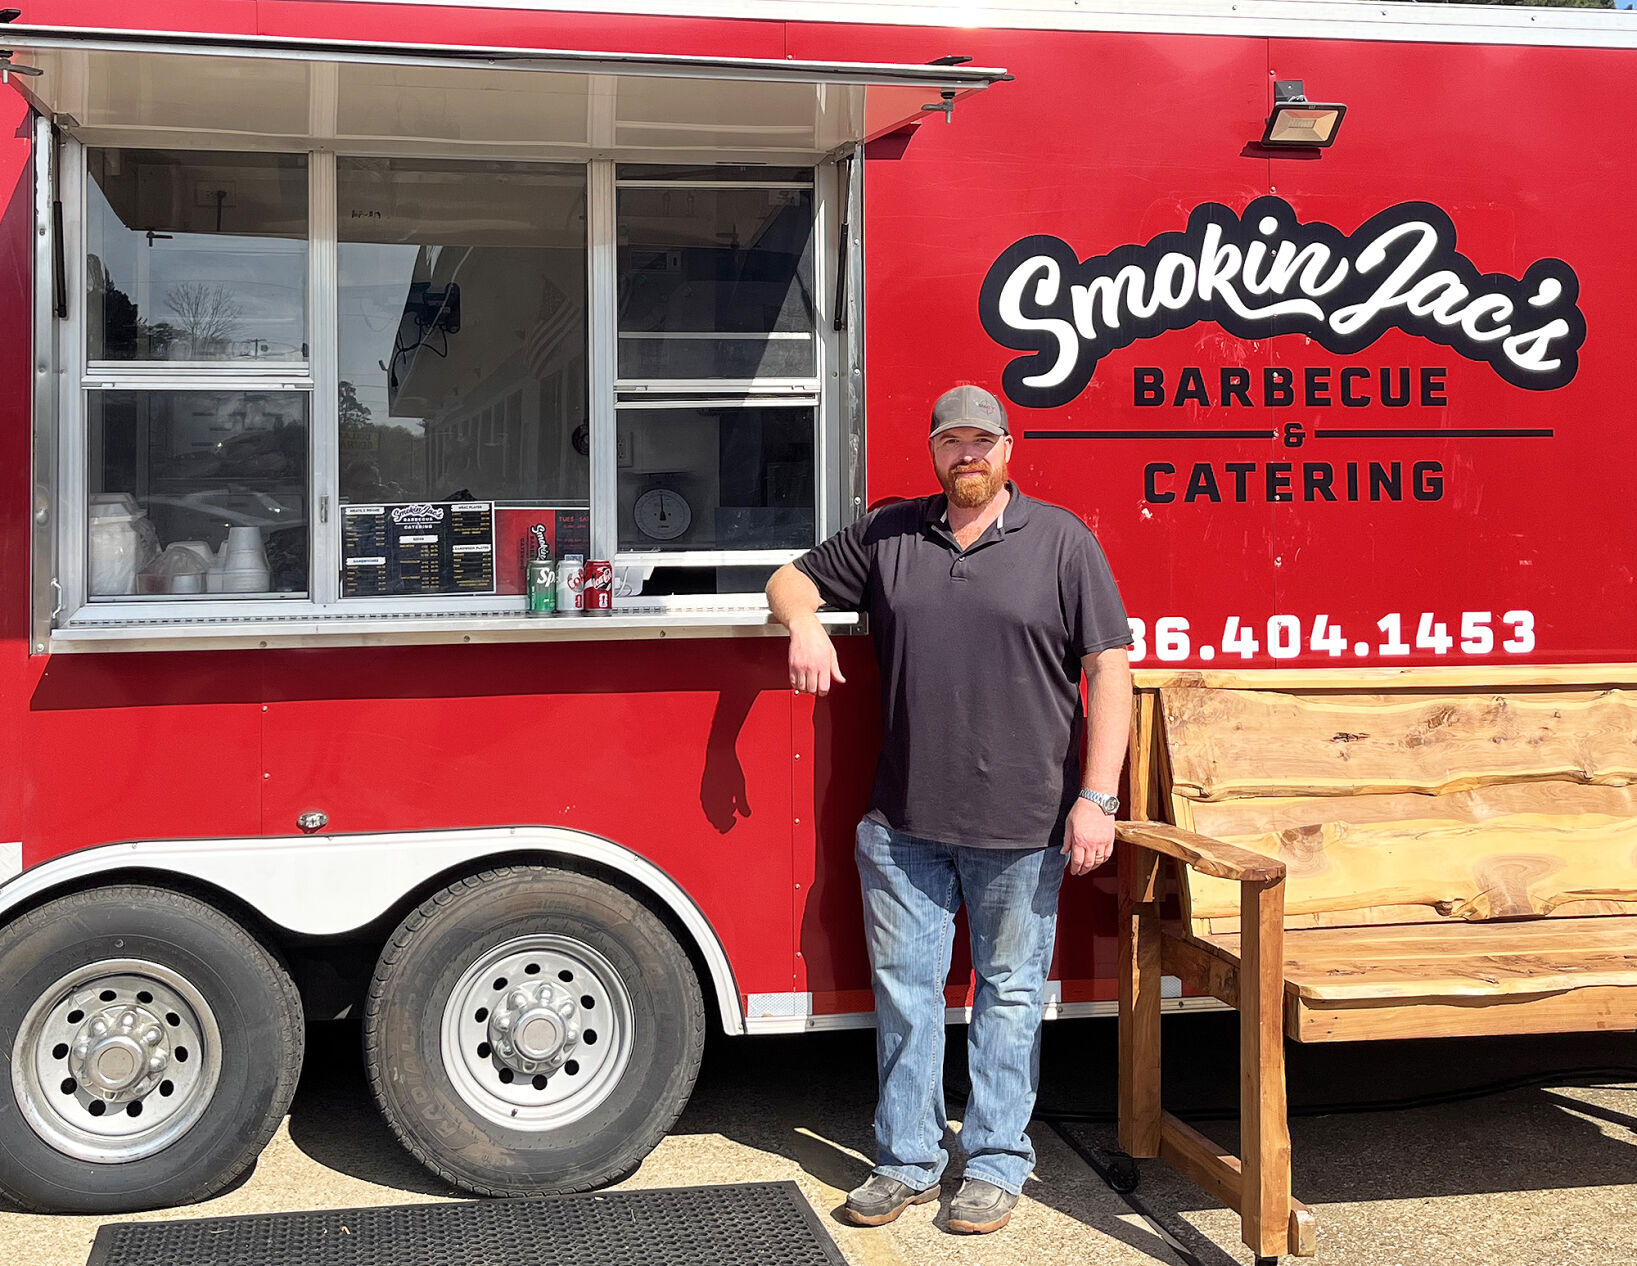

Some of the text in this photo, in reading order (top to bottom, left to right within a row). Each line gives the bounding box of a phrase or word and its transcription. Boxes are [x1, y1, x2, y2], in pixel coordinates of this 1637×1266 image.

[998, 215, 1571, 388] Smokin Jac's
[1133, 366, 1448, 407] BARBECUE
[1283, 422, 1307, 448] &
[1144, 460, 1445, 503] CATERING
